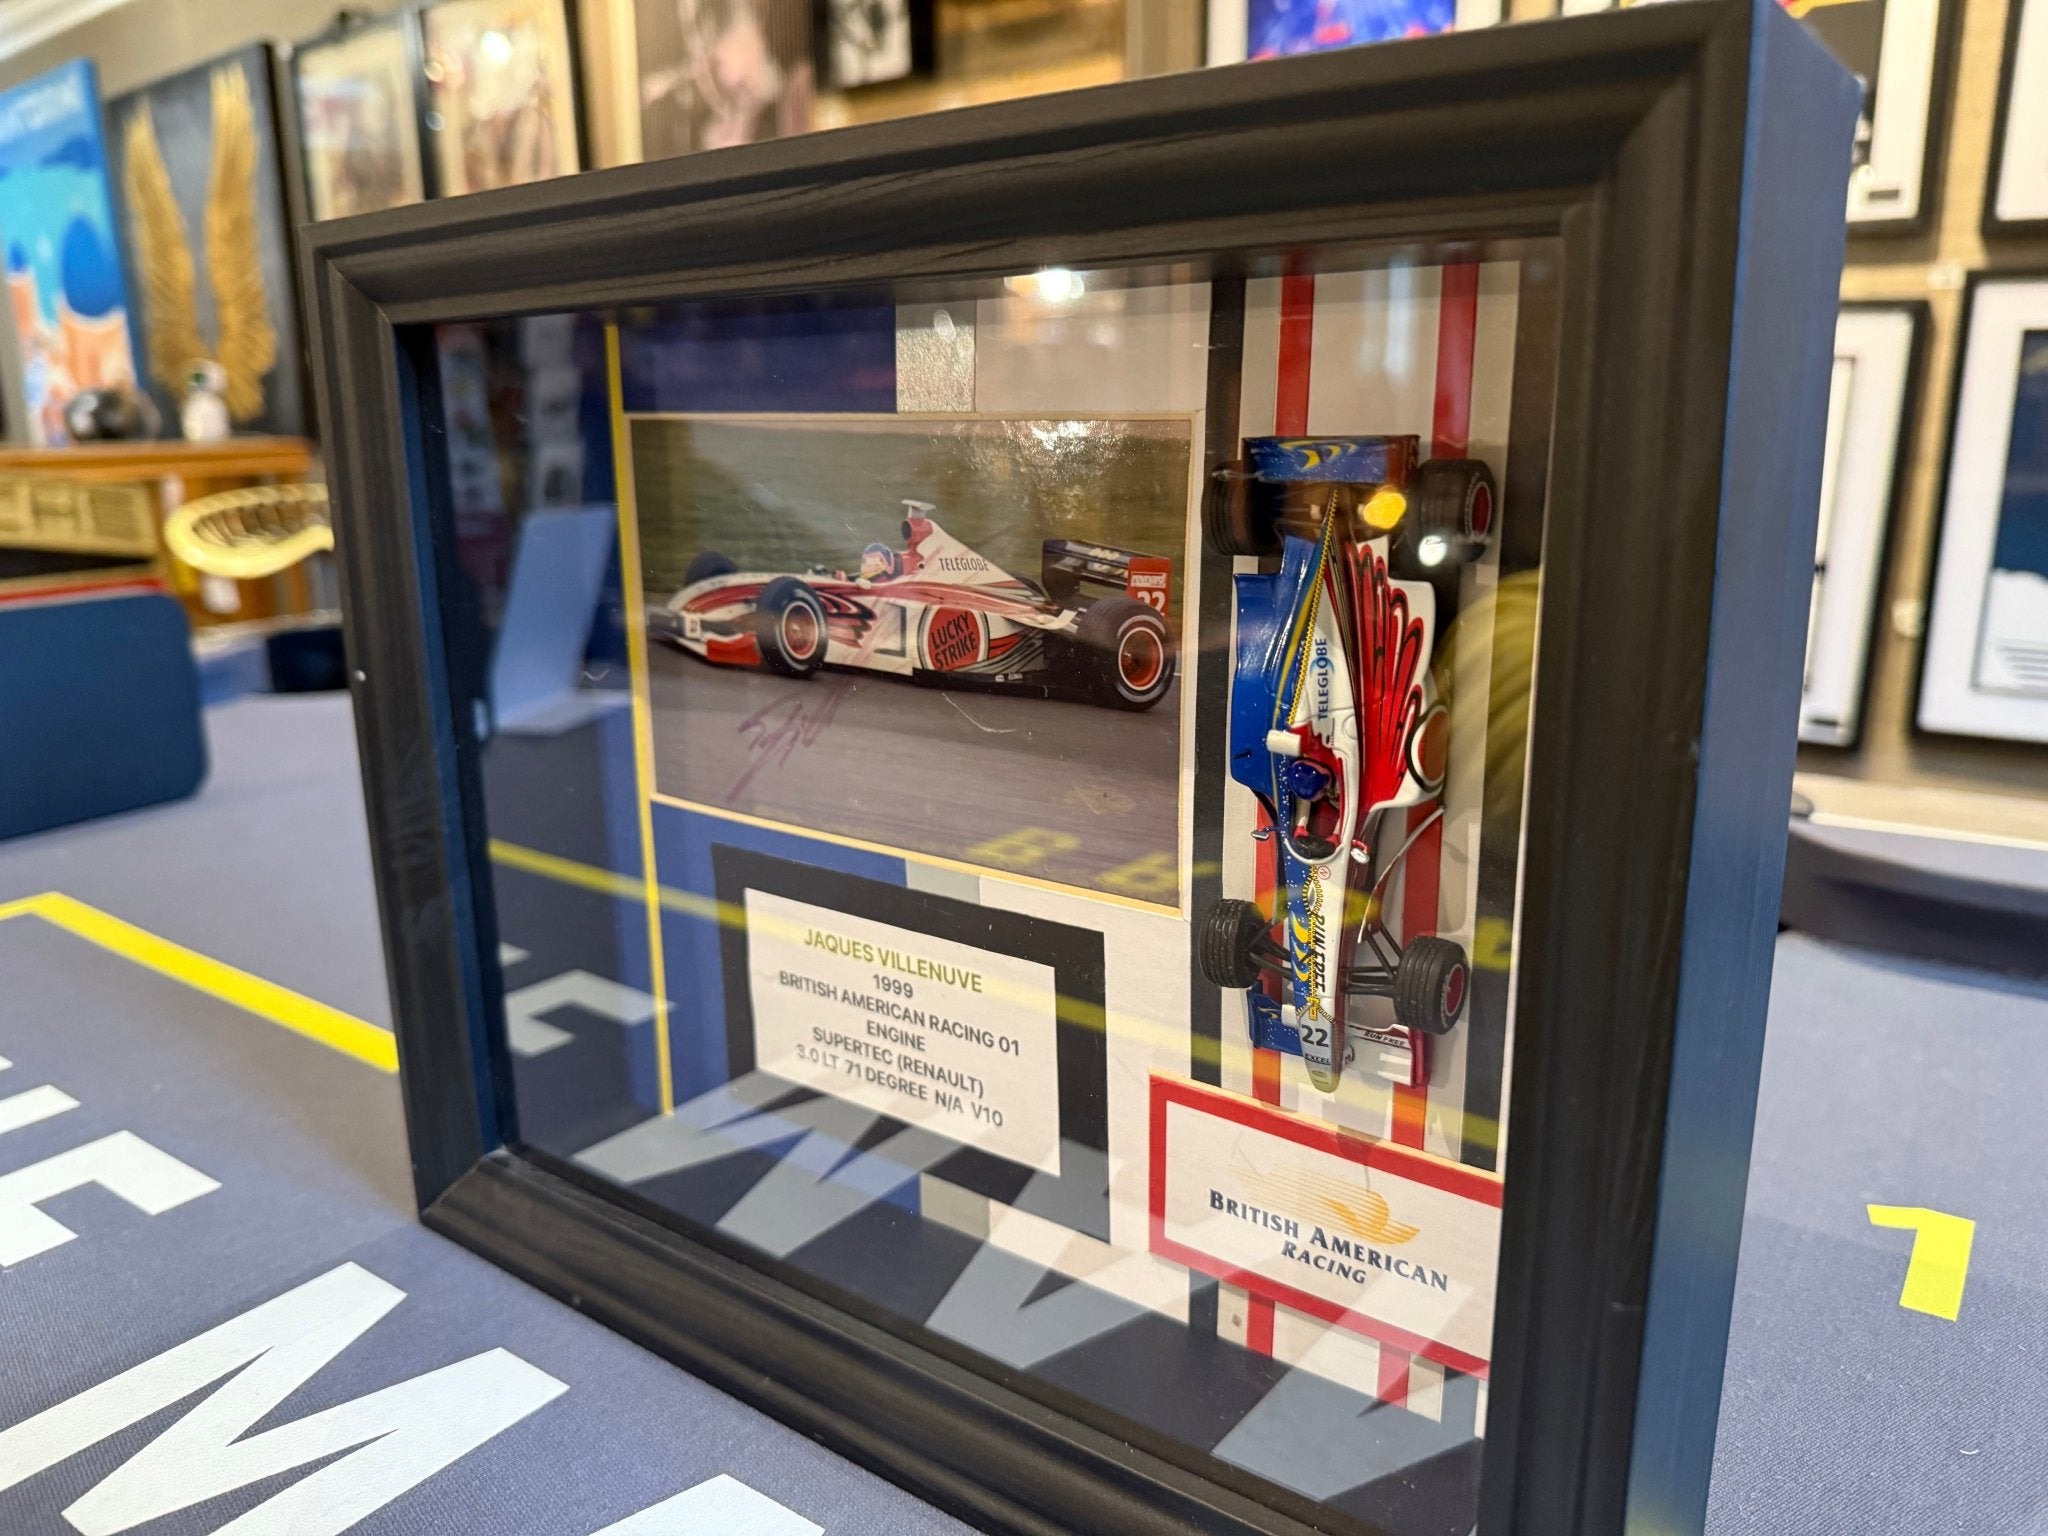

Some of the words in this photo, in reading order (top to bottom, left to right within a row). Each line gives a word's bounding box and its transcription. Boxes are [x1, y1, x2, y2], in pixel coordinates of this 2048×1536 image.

[938, 557, 990, 572] TELEGLOBE
[930, 610, 970, 651] LUCKY
[934, 631, 978, 672] STRIKE
[1315, 637, 1329, 722] TELEGLOBE
[804, 928, 874, 962] JAQUES
[877, 947, 983, 993] VILLENUVE
[873, 974, 914, 999] 1999
[779, 970, 838, 1001] BRITISH
[841, 989, 925, 1029] AMERICAN
[929, 1017, 995, 1049] RACING
[999, 1036, 1020, 1056] 01
[866, 1020, 926, 1052] ENGINE
[1302, 1024, 1329, 1049] 22
[812, 1027, 893, 1065] SUPERTEC
[897, 1053, 984, 1099] (RENAULT)
[1304, 1052, 1331, 1064] EXCEL
[796, 1044, 820, 1065] 3.0
[822, 1053, 839, 1071] LT
[846, 1060, 862, 1078] 71
[865, 1065, 928, 1101] DEGREE
[935, 1089, 964, 1114] N/A
[971, 1103, 1004, 1127] V10
[1209, 1188, 1300, 1239] BRITISH
[1309, 1226, 1448, 1293] AMERICAN
[1281, 1240, 1367, 1285] RACING
